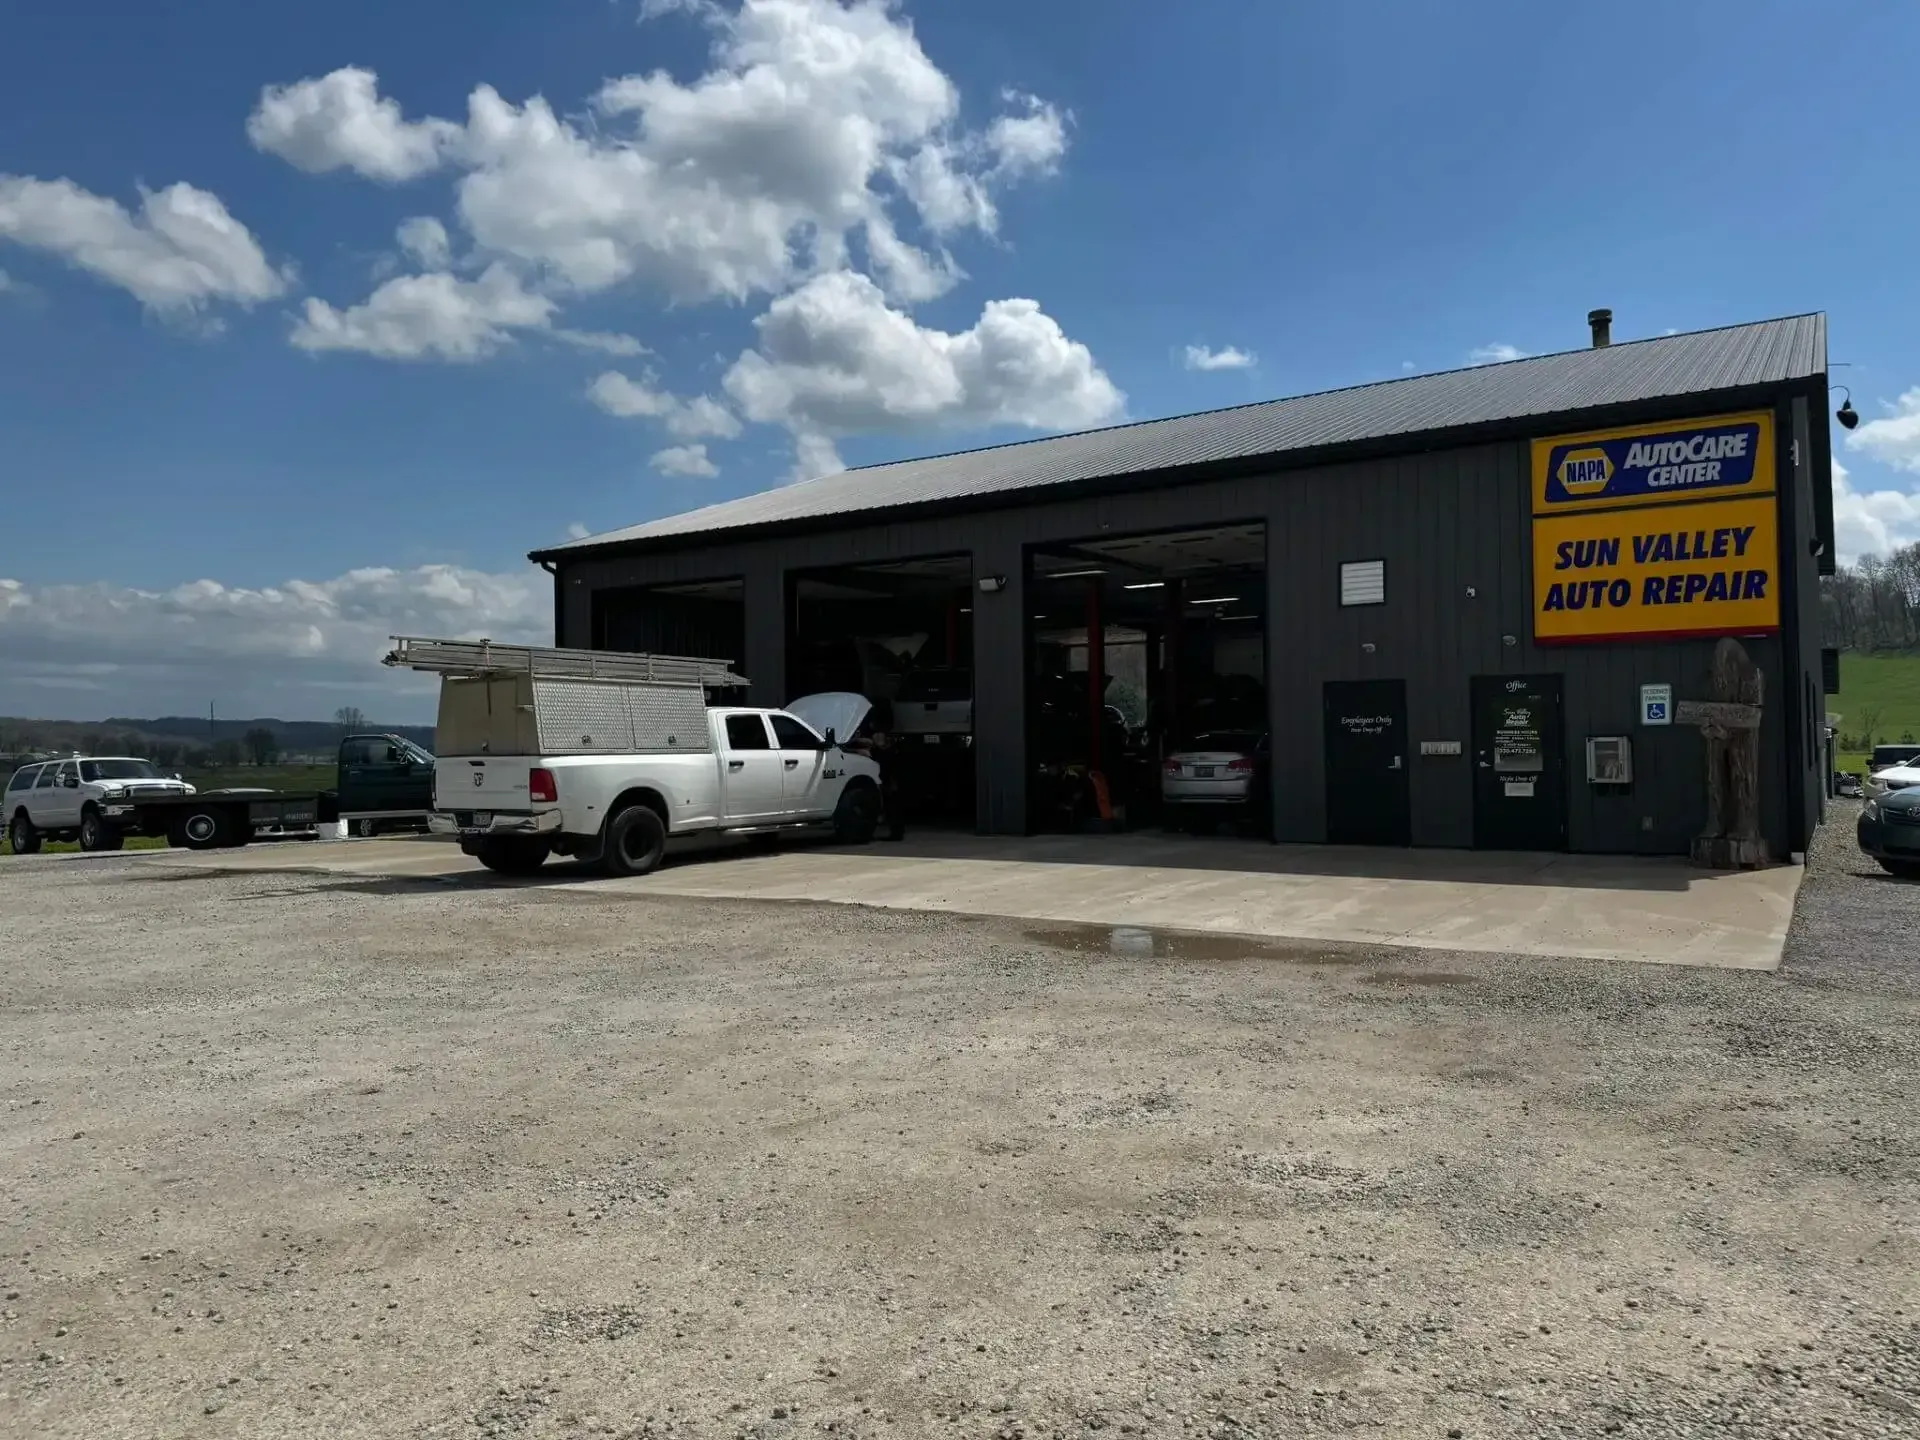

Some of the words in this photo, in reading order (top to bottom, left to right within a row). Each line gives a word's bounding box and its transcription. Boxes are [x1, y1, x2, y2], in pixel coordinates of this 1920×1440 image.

[1566, 459, 1606, 483] NAPA
[1647, 460, 1721, 487] CENTER
[1554, 537, 1620, 570] SUN
[1632, 526, 1756, 563] VALLEY
[1542, 578, 1631, 612] AUTO
[1642, 570, 1768, 606] REPAIR
[1505, 680, 1527, 692] Office
[1375, 715, 1392, 726] Only
